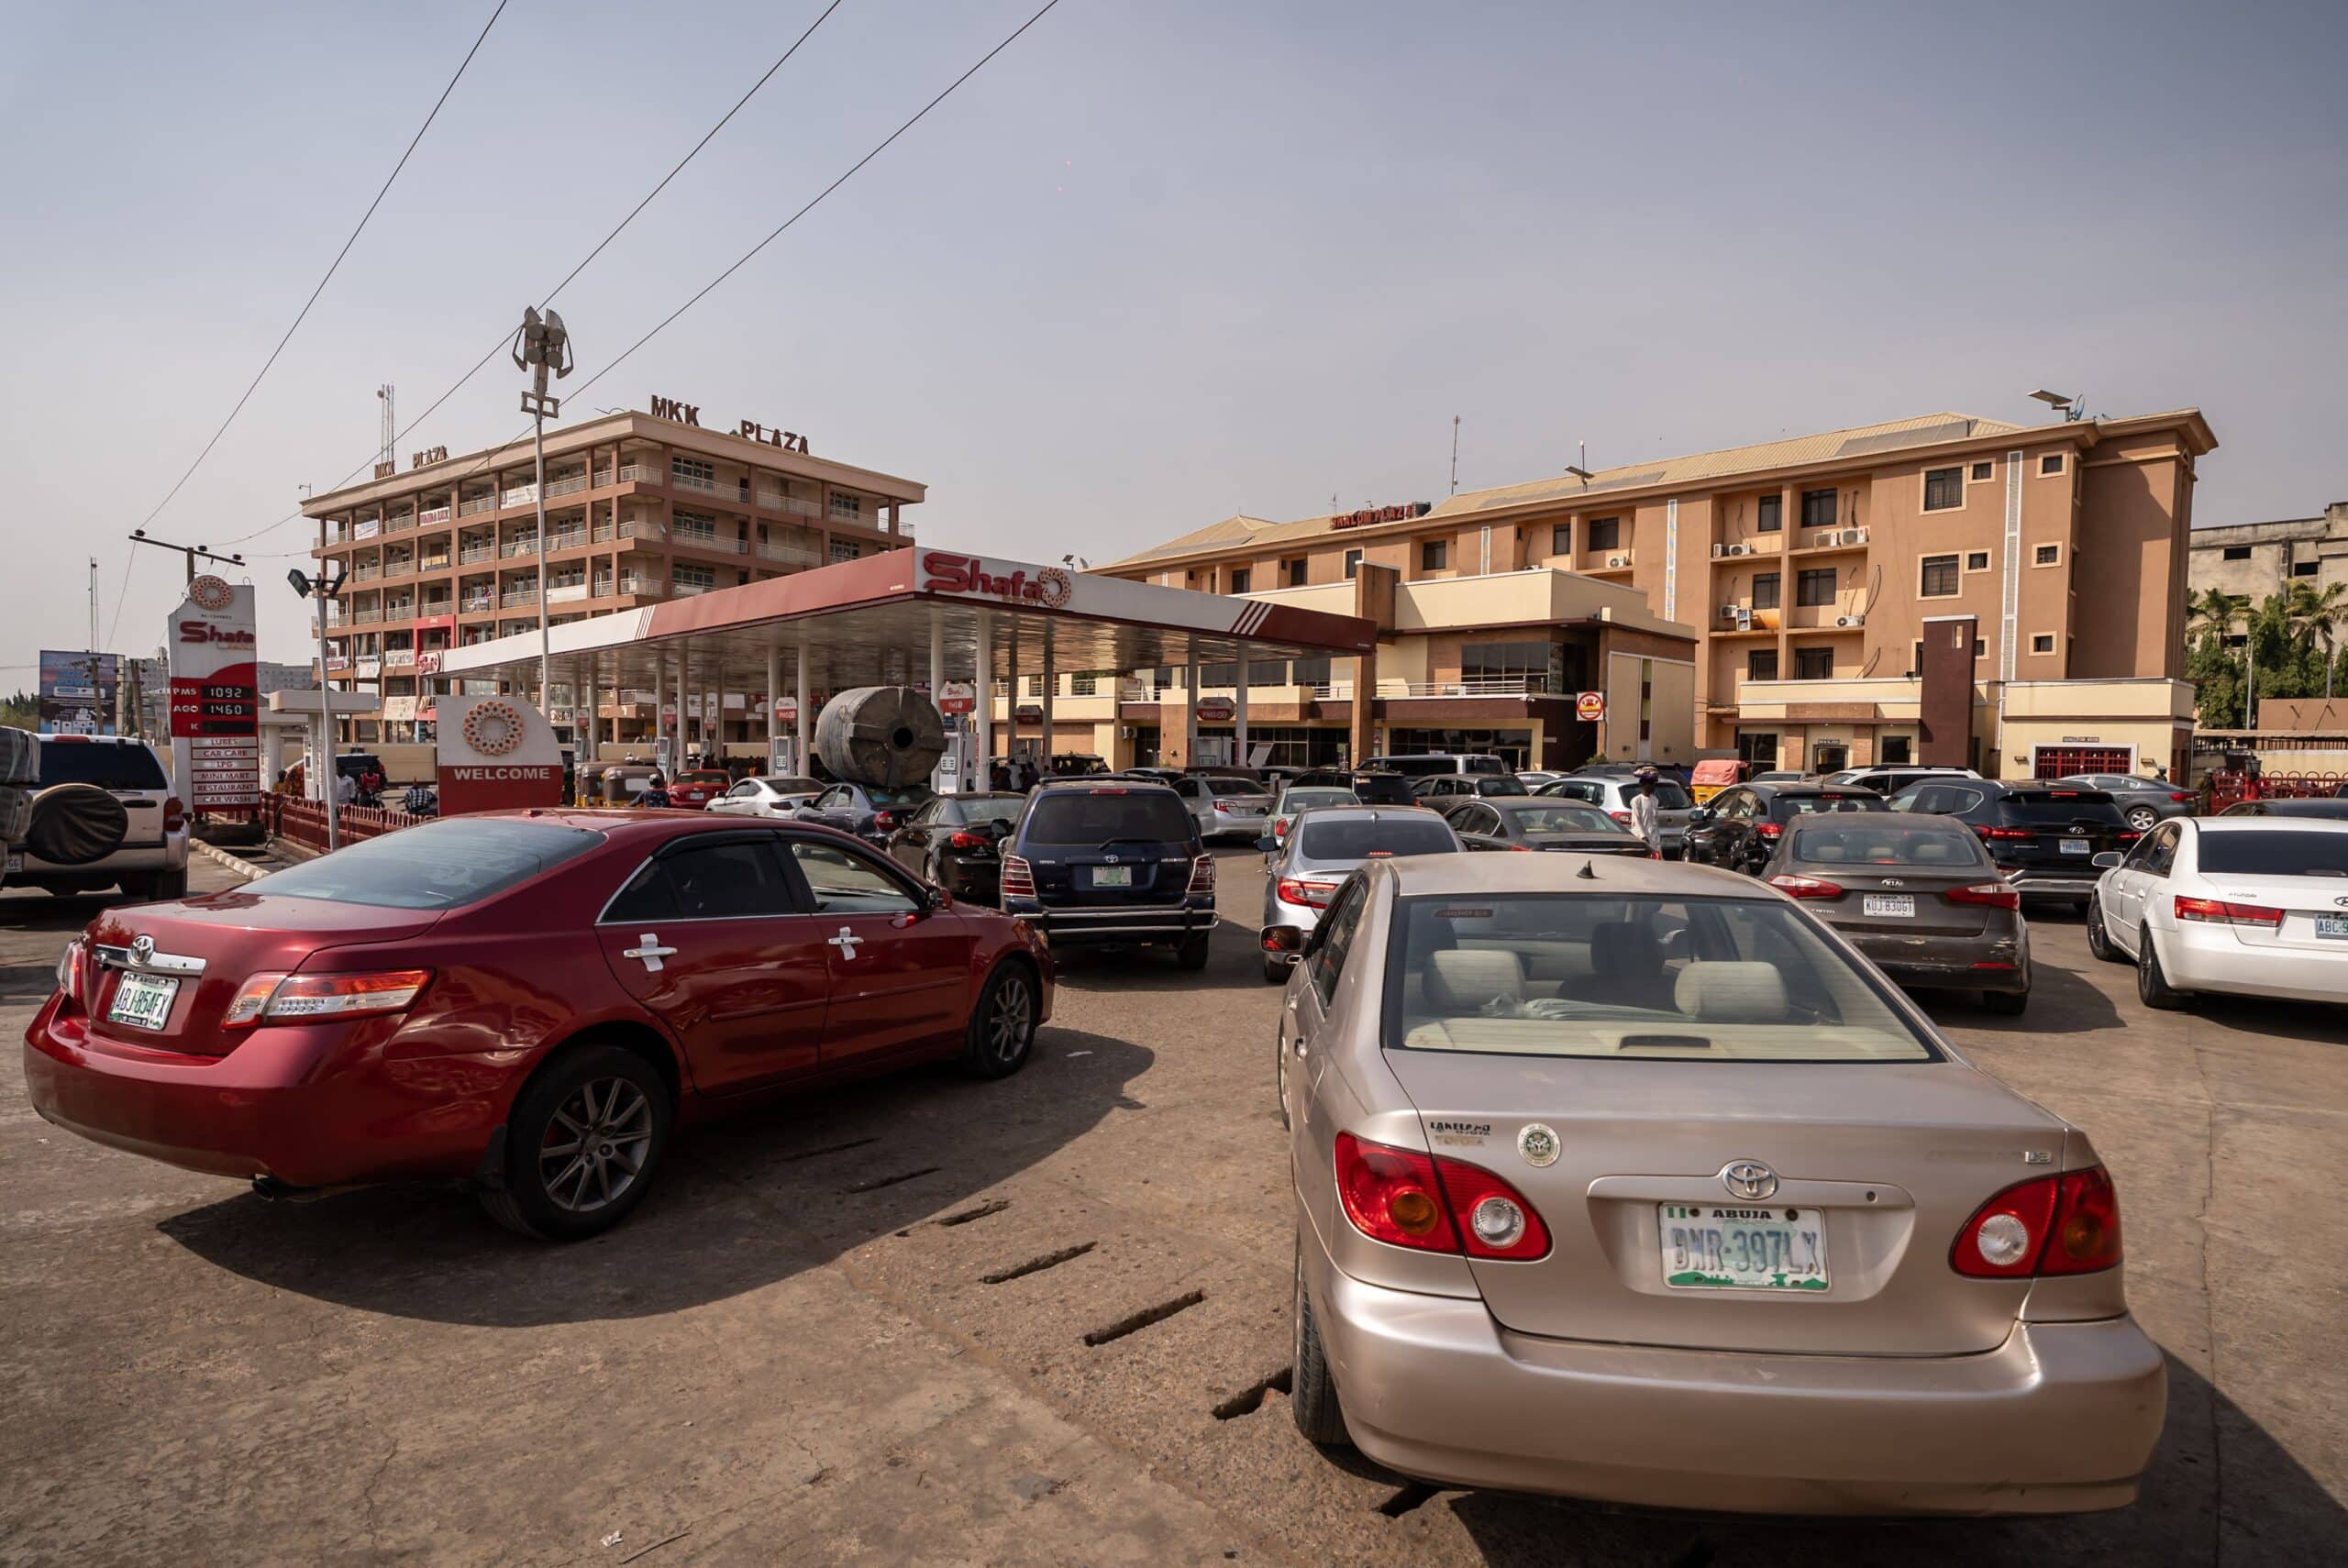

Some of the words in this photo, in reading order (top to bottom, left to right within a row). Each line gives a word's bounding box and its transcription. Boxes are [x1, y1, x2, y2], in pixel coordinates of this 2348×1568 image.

[651, 394, 700, 426] MKK
[741, 420, 809, 456] PLAZA
[413, 446, 448, 469] PLAZA
[1330, 512, 1371, 528] SHALOM
[1375, 505, 1413, 523] PLAZA
[924, 552, 1044, 599] Shafa
[180, 621, 254, 644] Shafa
[210, 687, 242, 698] 1092
[210, 705, 242, 715] 1460
[454, 768, 550, 780] WELCOME
[1712, 1209, 1772, 1220] ABUJA
